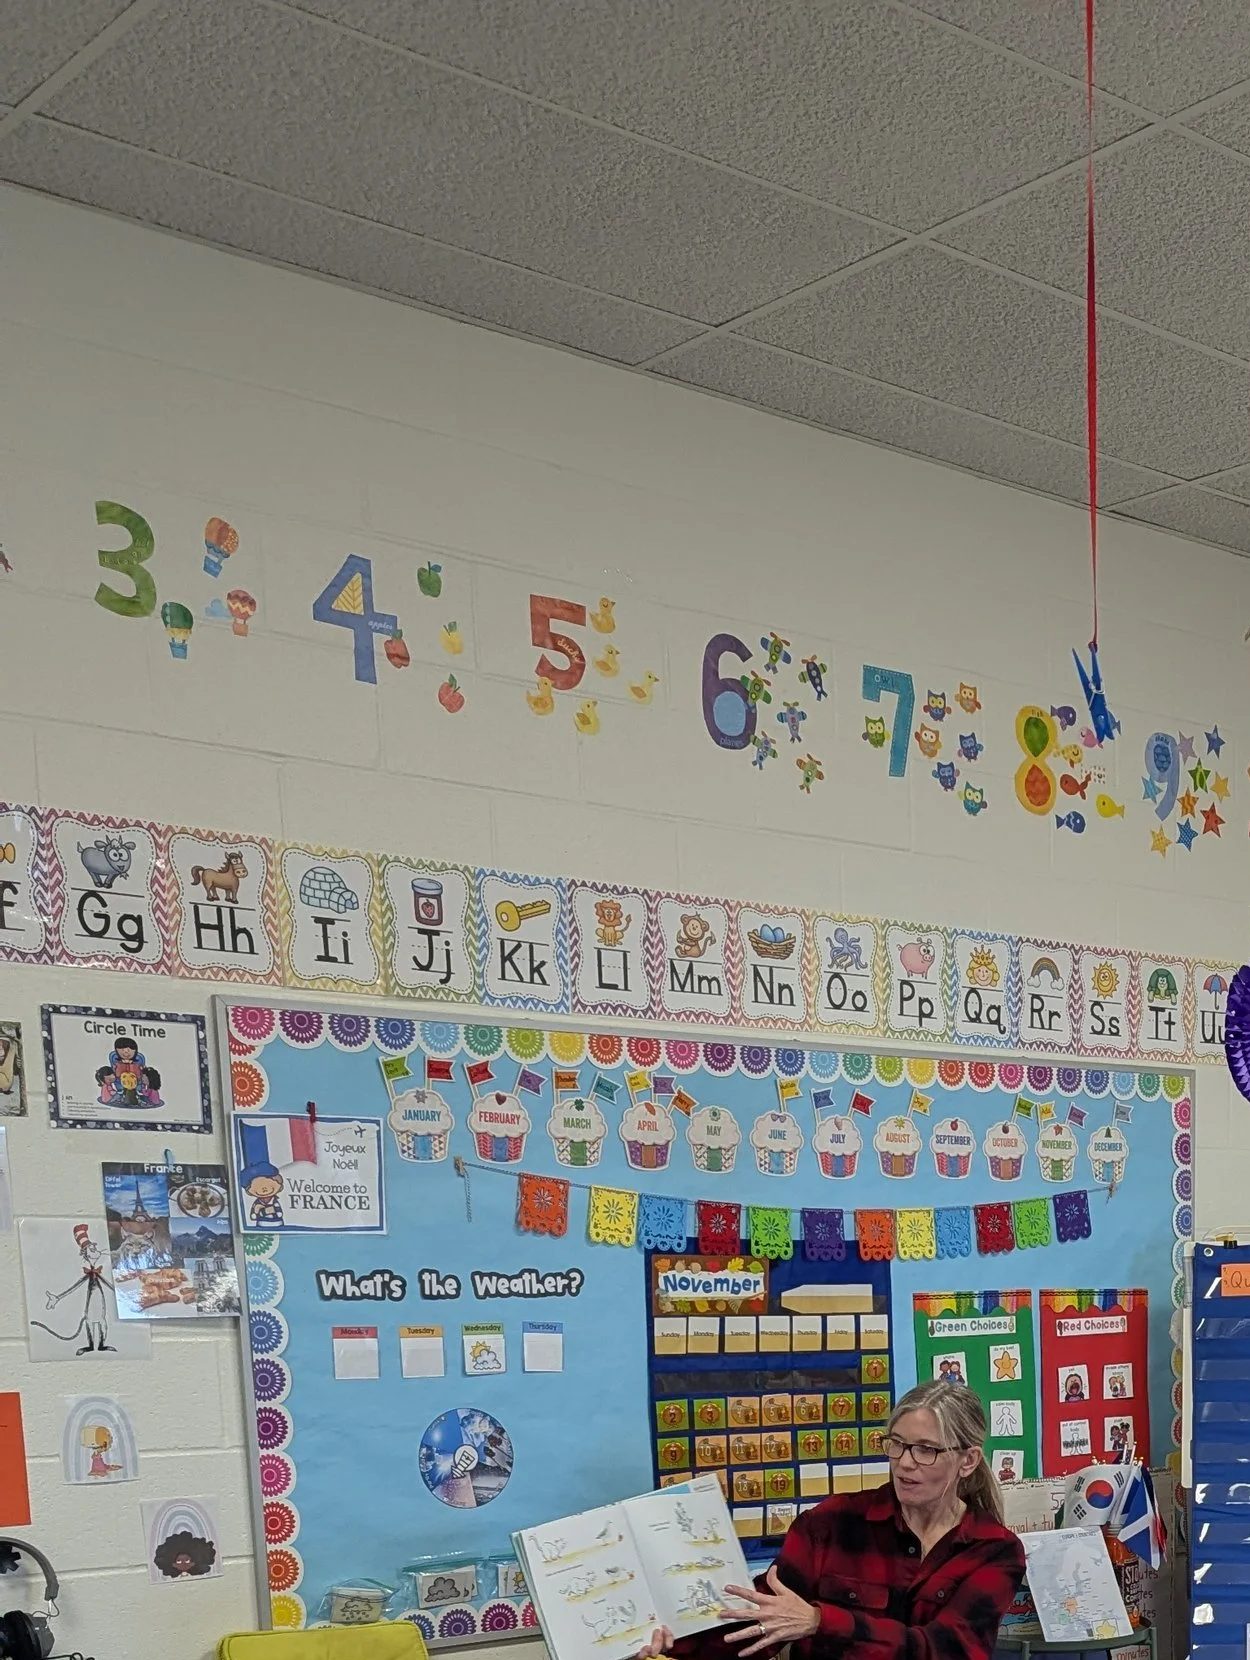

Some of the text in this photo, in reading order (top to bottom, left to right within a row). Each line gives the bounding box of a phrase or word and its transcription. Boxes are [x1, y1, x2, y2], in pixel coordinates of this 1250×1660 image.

[95, 500, 157, 618] 3
[313, 554, 397, 684] 4
[530, 594, 586, 690] 5
[702, 633, 757, 750] 6
[862, 664, 915, 777] 7
[1015, 705, 1057, 815] 8
[1145, 732, 1180, 822] 9
[78, 891, 144, 953] Gg
[194, 904, 256, 955] Hh
[314, 917, 352, 963] Ii
[411, 929, 455, 985] Jj
[499, 940, 550, 986] Kk
[596, 949, 630, 991] Ll
[669, 959, 722, 996] Mm
[752, 967, 796, 1006] Nn
[825, 973, 868, 1011] Oo
[899, 981, 935, 1027] Pp
[964, 988, 1006, 1036] Qq
[1029, 994, 1061, 1031] Rr
[1090, 1001, 1120, 1036] Ss
[1149, 1006, 1176, 1041] Tt
[84, 1020, 167, 1038] Circle Time
[402, 1110, 441, 1122] JANUARY
[479, 1111, 521, 1126] FEBRUARY
[563, 1117, 591, 1130] MARCH
[637, 1120, 659, 1132] APRIL
[706, 1125, 722, 1137] MAY
[768, 1129, 788, 1141] JUNE
[829, 1133, 846, 1144] JULY
[885, 1132, 911, 1144] AUGUST
[935, 1134, 971, 1147] SEPTEMBER
[324, 1142, 366, 1160] Joyeux
[992, 1138, 1018, 1148] OCTOBER
[1041, 1140, 1073, 1150] NOVEMBER
[1094, 1142, 1123, 1152] DECEMBER
[287, 1178, 367, 1194] Welcome to
[288, 1194, 370, 1211] FRANCE
[319, 1271, 582, 1298] What's the Weather?
[663, 1273, 761, 1296] November
[406, 1327, 435, 1336] Tuesday
[464, 1324, 502, 1333] Wednesday
[528, 1322, 558, 1331] Thursday
[935, 1319, 1008, 1333] Green Choices
[1064, 1319, 1121, 1332] Red Choices
[839, 1439, 850, 1449] 14
[774, 1479, 786, 1490] 19
